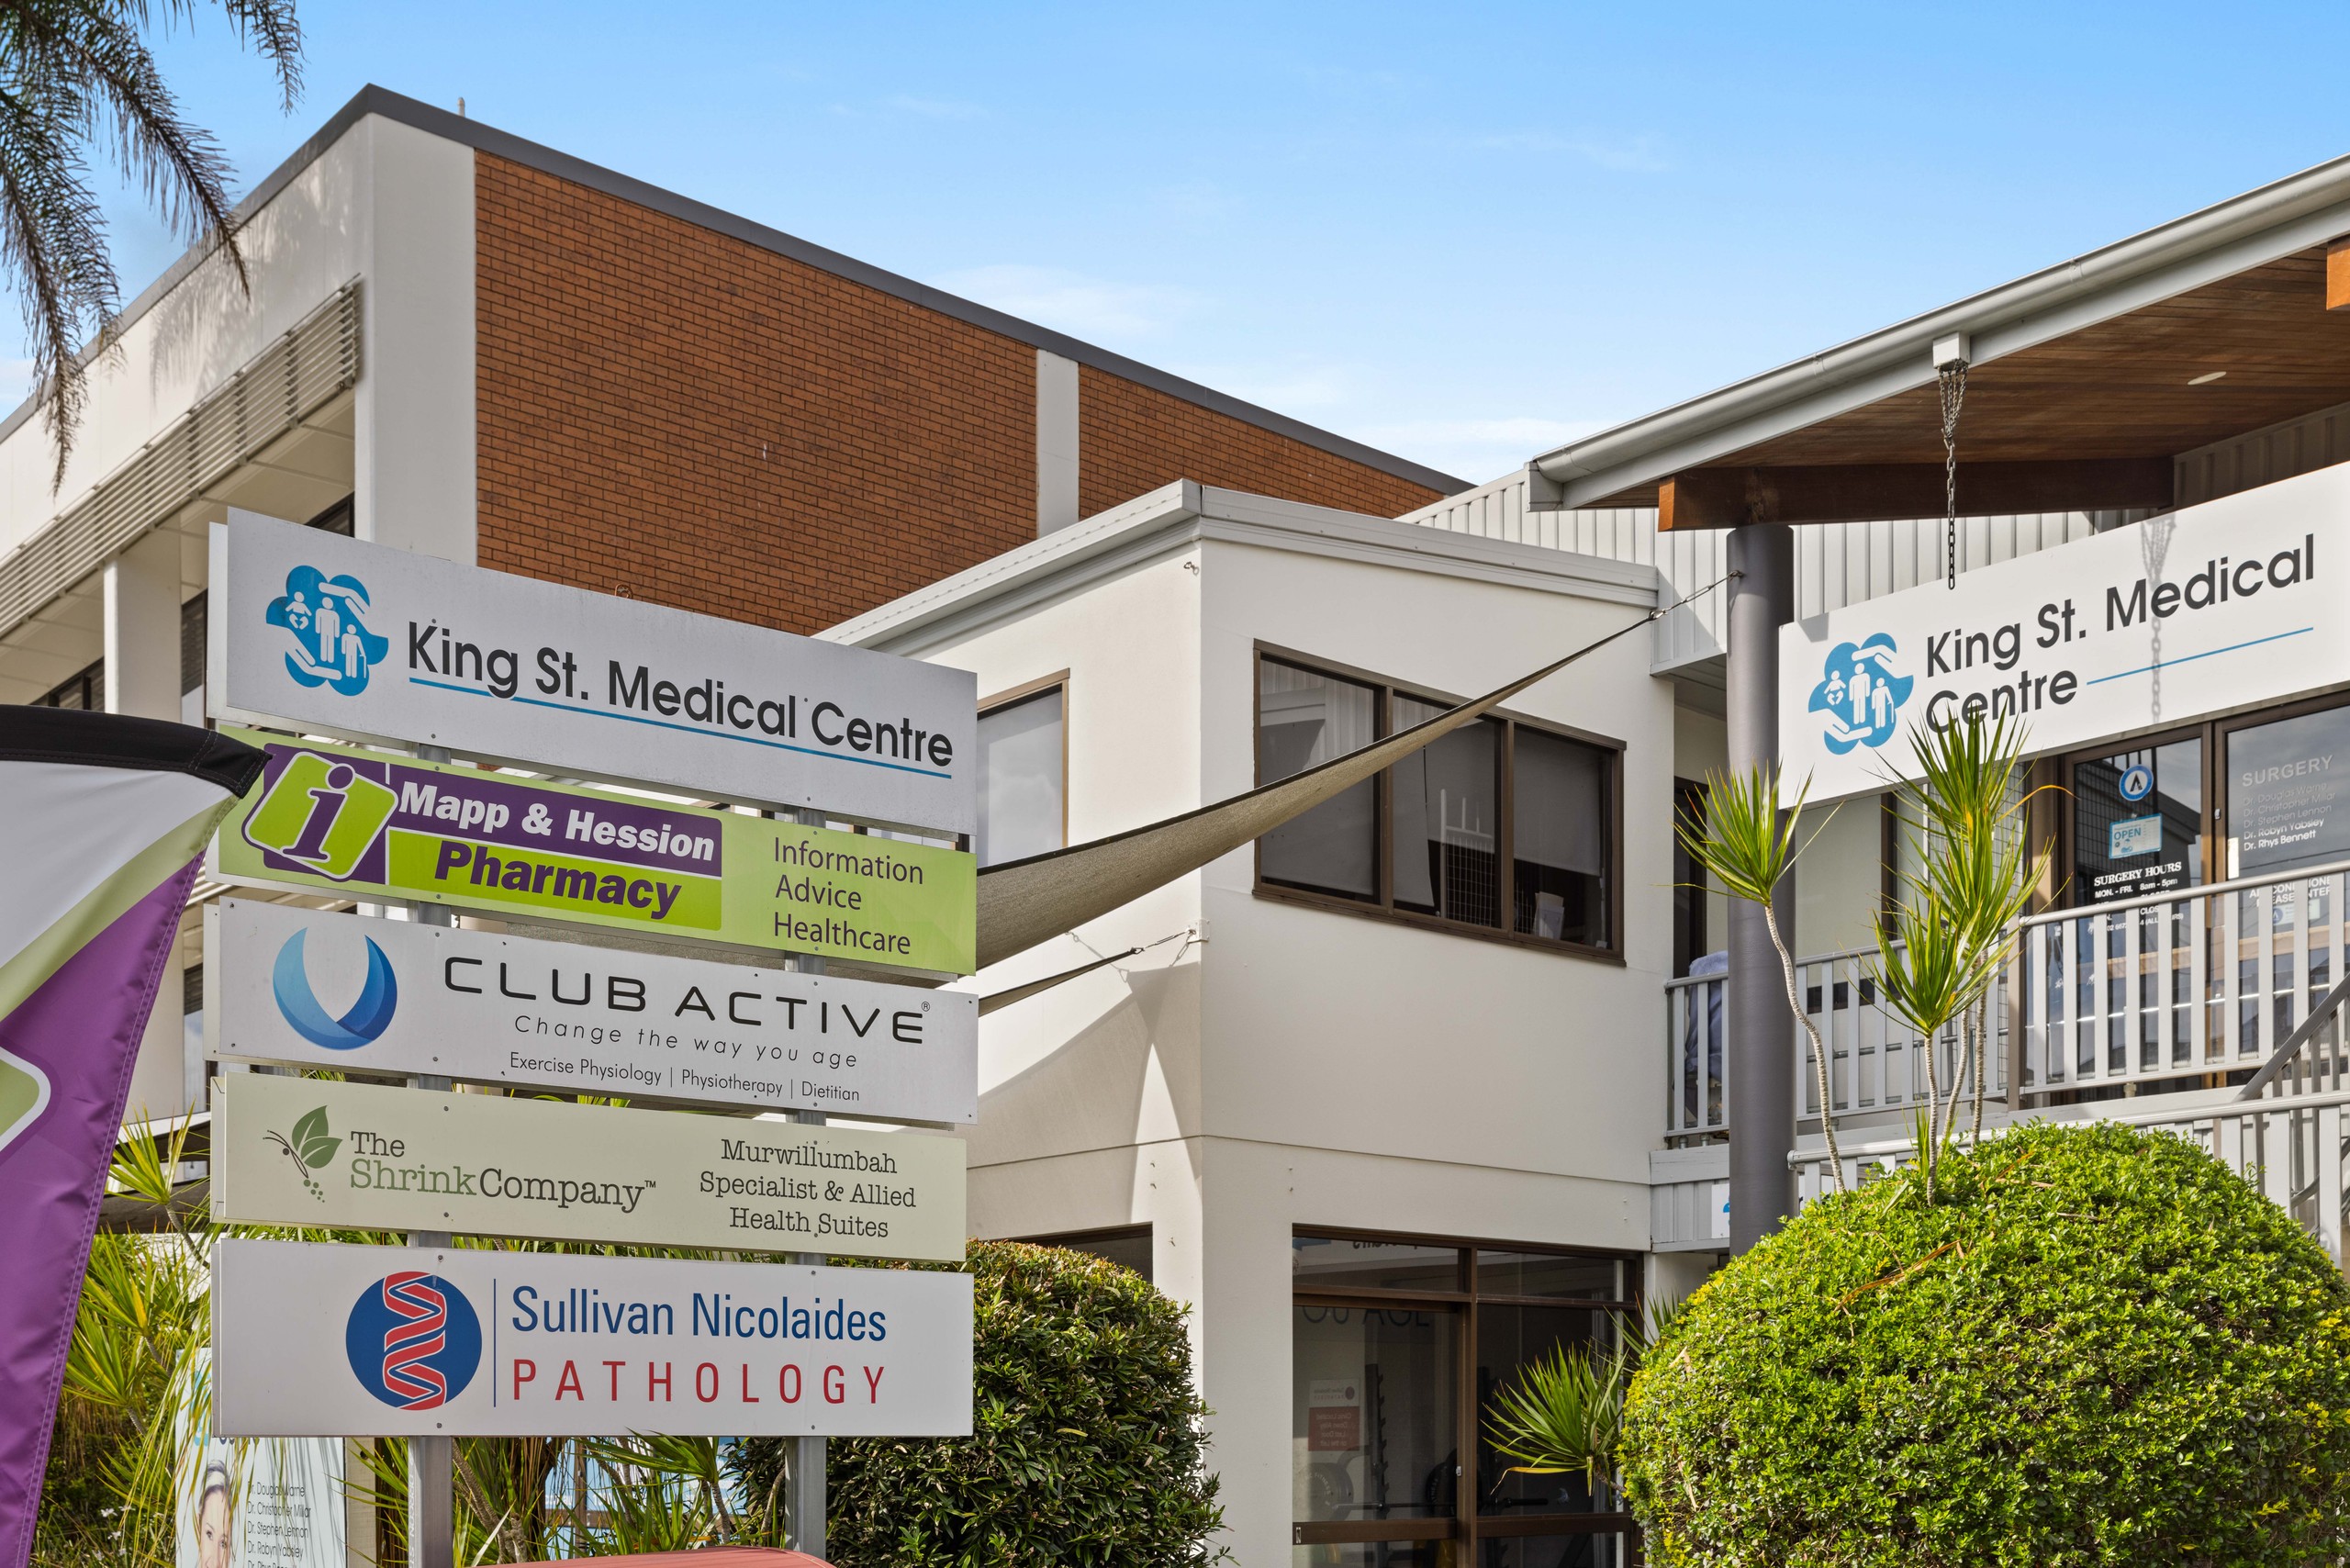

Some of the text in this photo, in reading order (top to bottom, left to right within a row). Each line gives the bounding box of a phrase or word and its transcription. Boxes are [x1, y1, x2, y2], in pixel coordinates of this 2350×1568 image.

[1928, 533, 2313, 678] King St. Medical
[409, 621, 954, 767] King St. Medical Centre
[1927, 671, 2077, 734] Centre
[2242, 755, 2333, 787] SURGERY
[399, 780, 716, 861] Mapp & Hession
[2244, 792, 2335, 817] Dr. Christopher Millar
[2244, 804, 2332, 829] Dr. Stephen Lennon
[2113, 827, 2142, 840] OPEN
[2244, 818, 2324, 840] Dr. Robyn Yabsley
[2244, 829, 2316, 851] Dr. Rhys Bennett
[775, 836, 924, 884] Information
[2094, 861, 2182, 887] SURGERY HOURS
[435, 841, 681, 920] Pharmacy
[775, 873, 863, 911] Advice
[2095, 889, 2114, 899] MON.
[2120, 885, 2133, 894] FRI.
[2140, 882, 2155, 890] 8am
[2162, 879, 2178, 888] 5pm
[774, 912, 911, 956] Healthcare
[445, 957, 646, 1013] CLUB
[515, 1014, 856, 1070] Change the way you age
[510, 1052, 859, 1102] Exercise Physiology Physiotherapy Dietitian
[351, 1130, 405, 1161] The
[721, 1138, 898, 1174] Murwillumbah
[699, 1170, 917, 1208] Specialist & Allied
[730, 1206, 889, 1238] Health Suites
[513, 1285, 886, 1341] Sullivan Nicolaides
[513, 1358, 884, 1405] PATHOLOGY
[248, 1501, 256, 1515] Dr.
[248, 1520, 256, 1534] Dr.
[257, 1521, 283, 1539] Stephen
[248, 1540, 256, 1554] Dr.
[257, 1541, 276, 1558] Robyn
